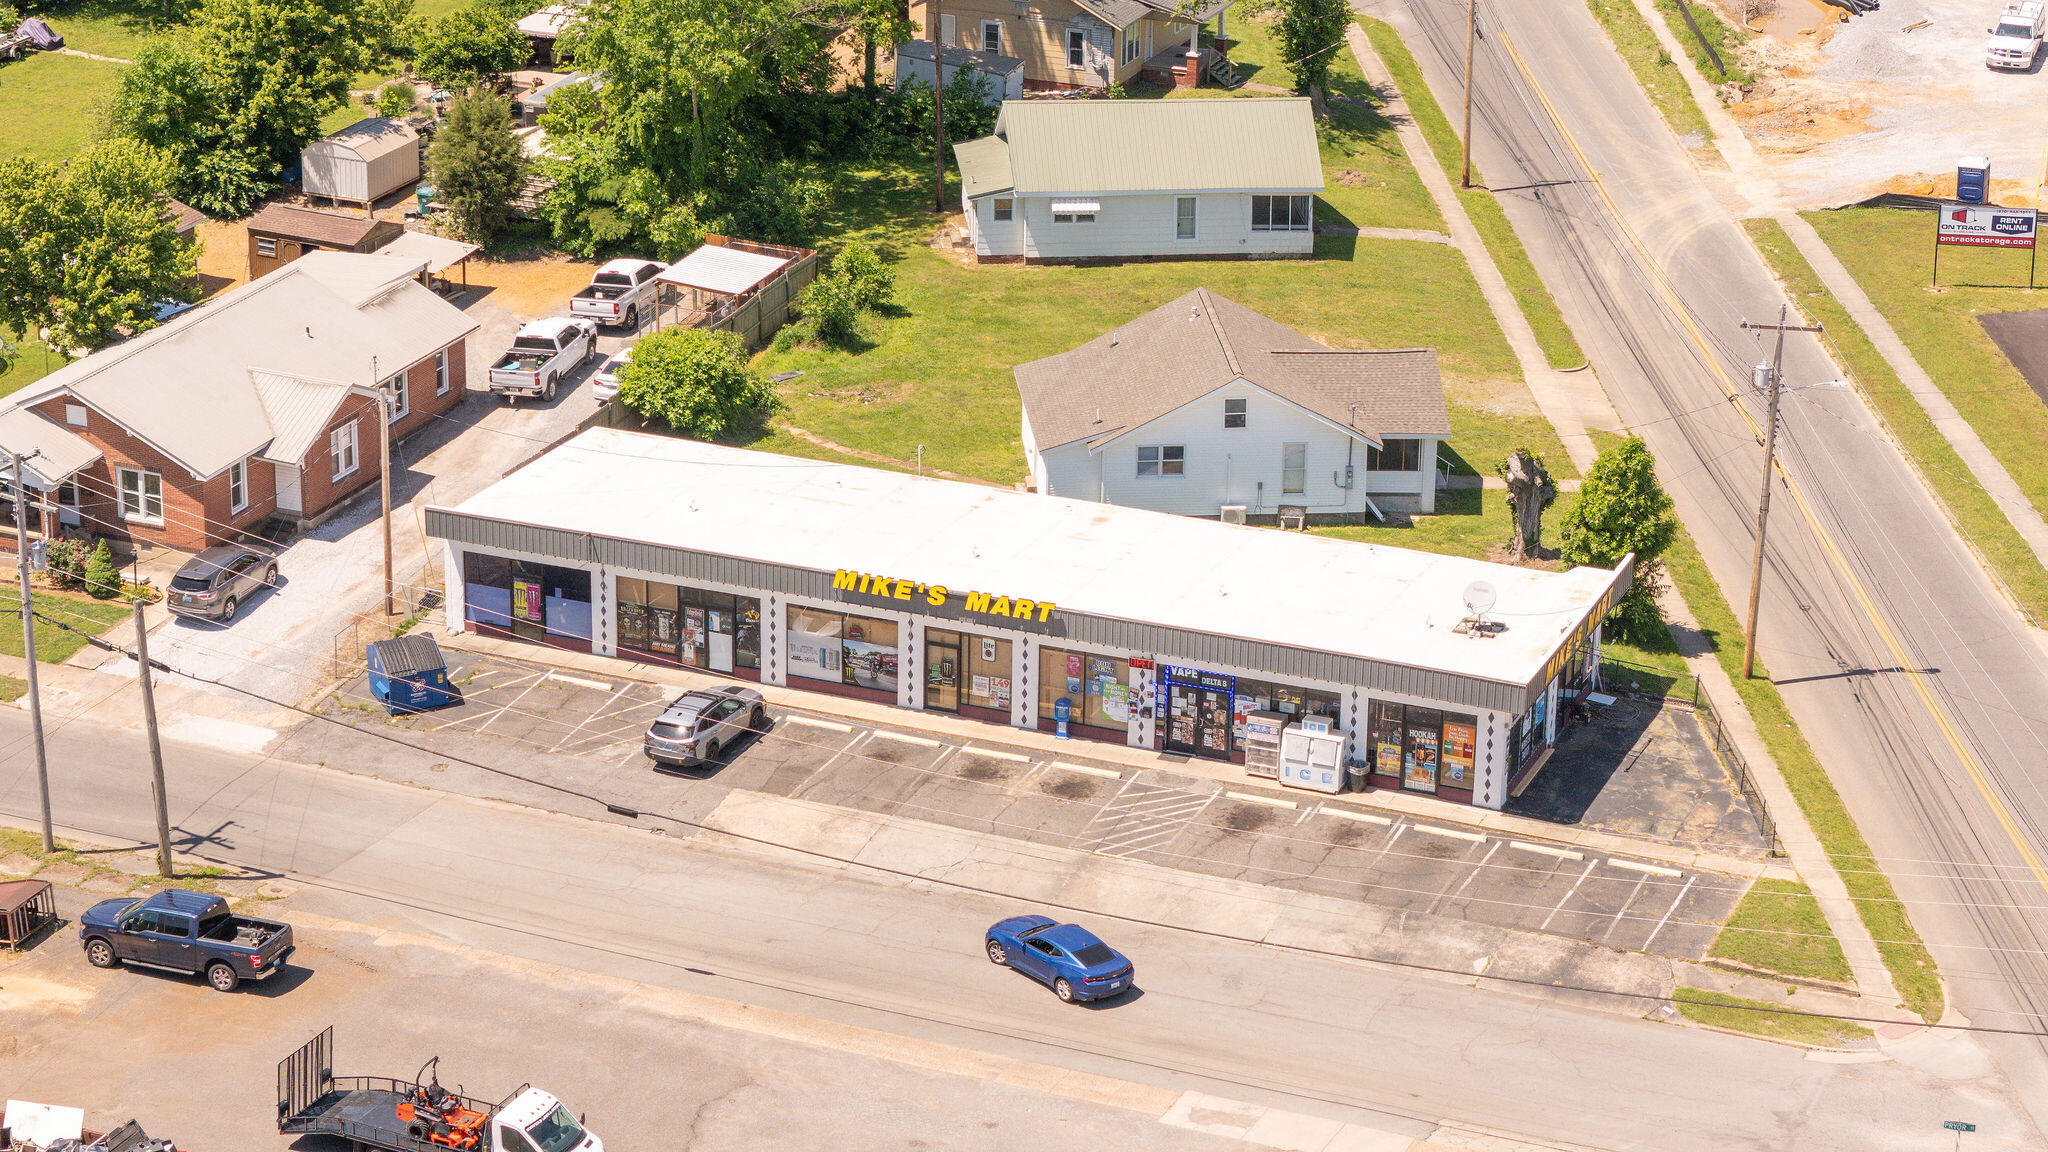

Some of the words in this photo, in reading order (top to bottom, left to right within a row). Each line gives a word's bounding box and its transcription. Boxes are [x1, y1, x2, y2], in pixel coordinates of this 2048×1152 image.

[1941, 223, 1955, 231] ON
[832, 568, 949, 607] MIKE'S
[964, 590, 1056, 623] MART
[1171, 666, 1198, 679] VAPE
[1201, 677, 1221, 687] DELTA
[1303, 720, 1326, 732] ICE
[1409, 729, 1436, 740] HOOKAH
